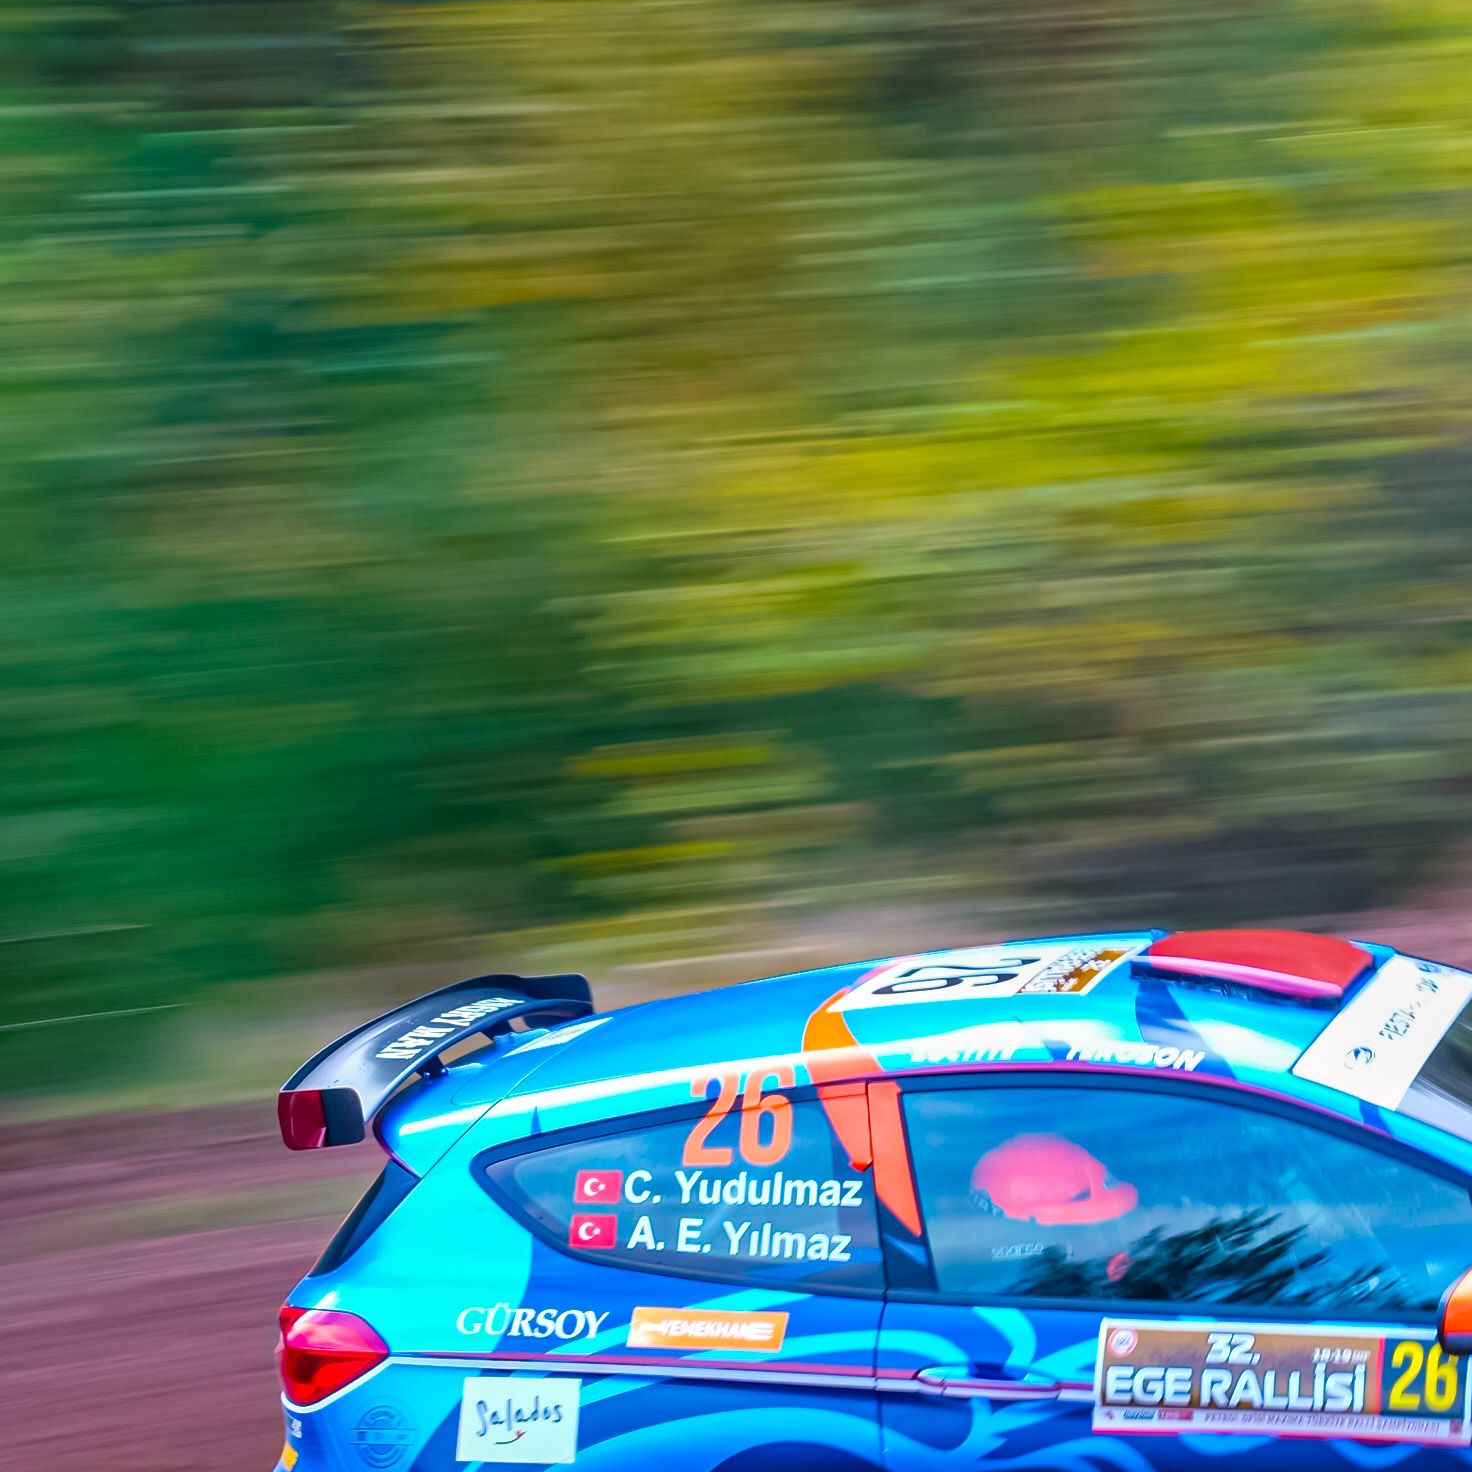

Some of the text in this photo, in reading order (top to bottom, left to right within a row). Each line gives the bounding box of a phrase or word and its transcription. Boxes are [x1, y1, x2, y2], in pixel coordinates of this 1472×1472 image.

[682, 1064, 795, 1167] 26
[624, 1170, 863, 1207] C. Yudulmaz
[626, 1215, 852, 1262] A. E. Yılmaz
[456, 1302, 609, 1339] GÜRSOY
[658, 1319, 775, 1341] YEMEKHANE
[1105, 1362, 1367, 1414] EGE RALLİSİ
[1389, 1341, 1459, 1412] 26
